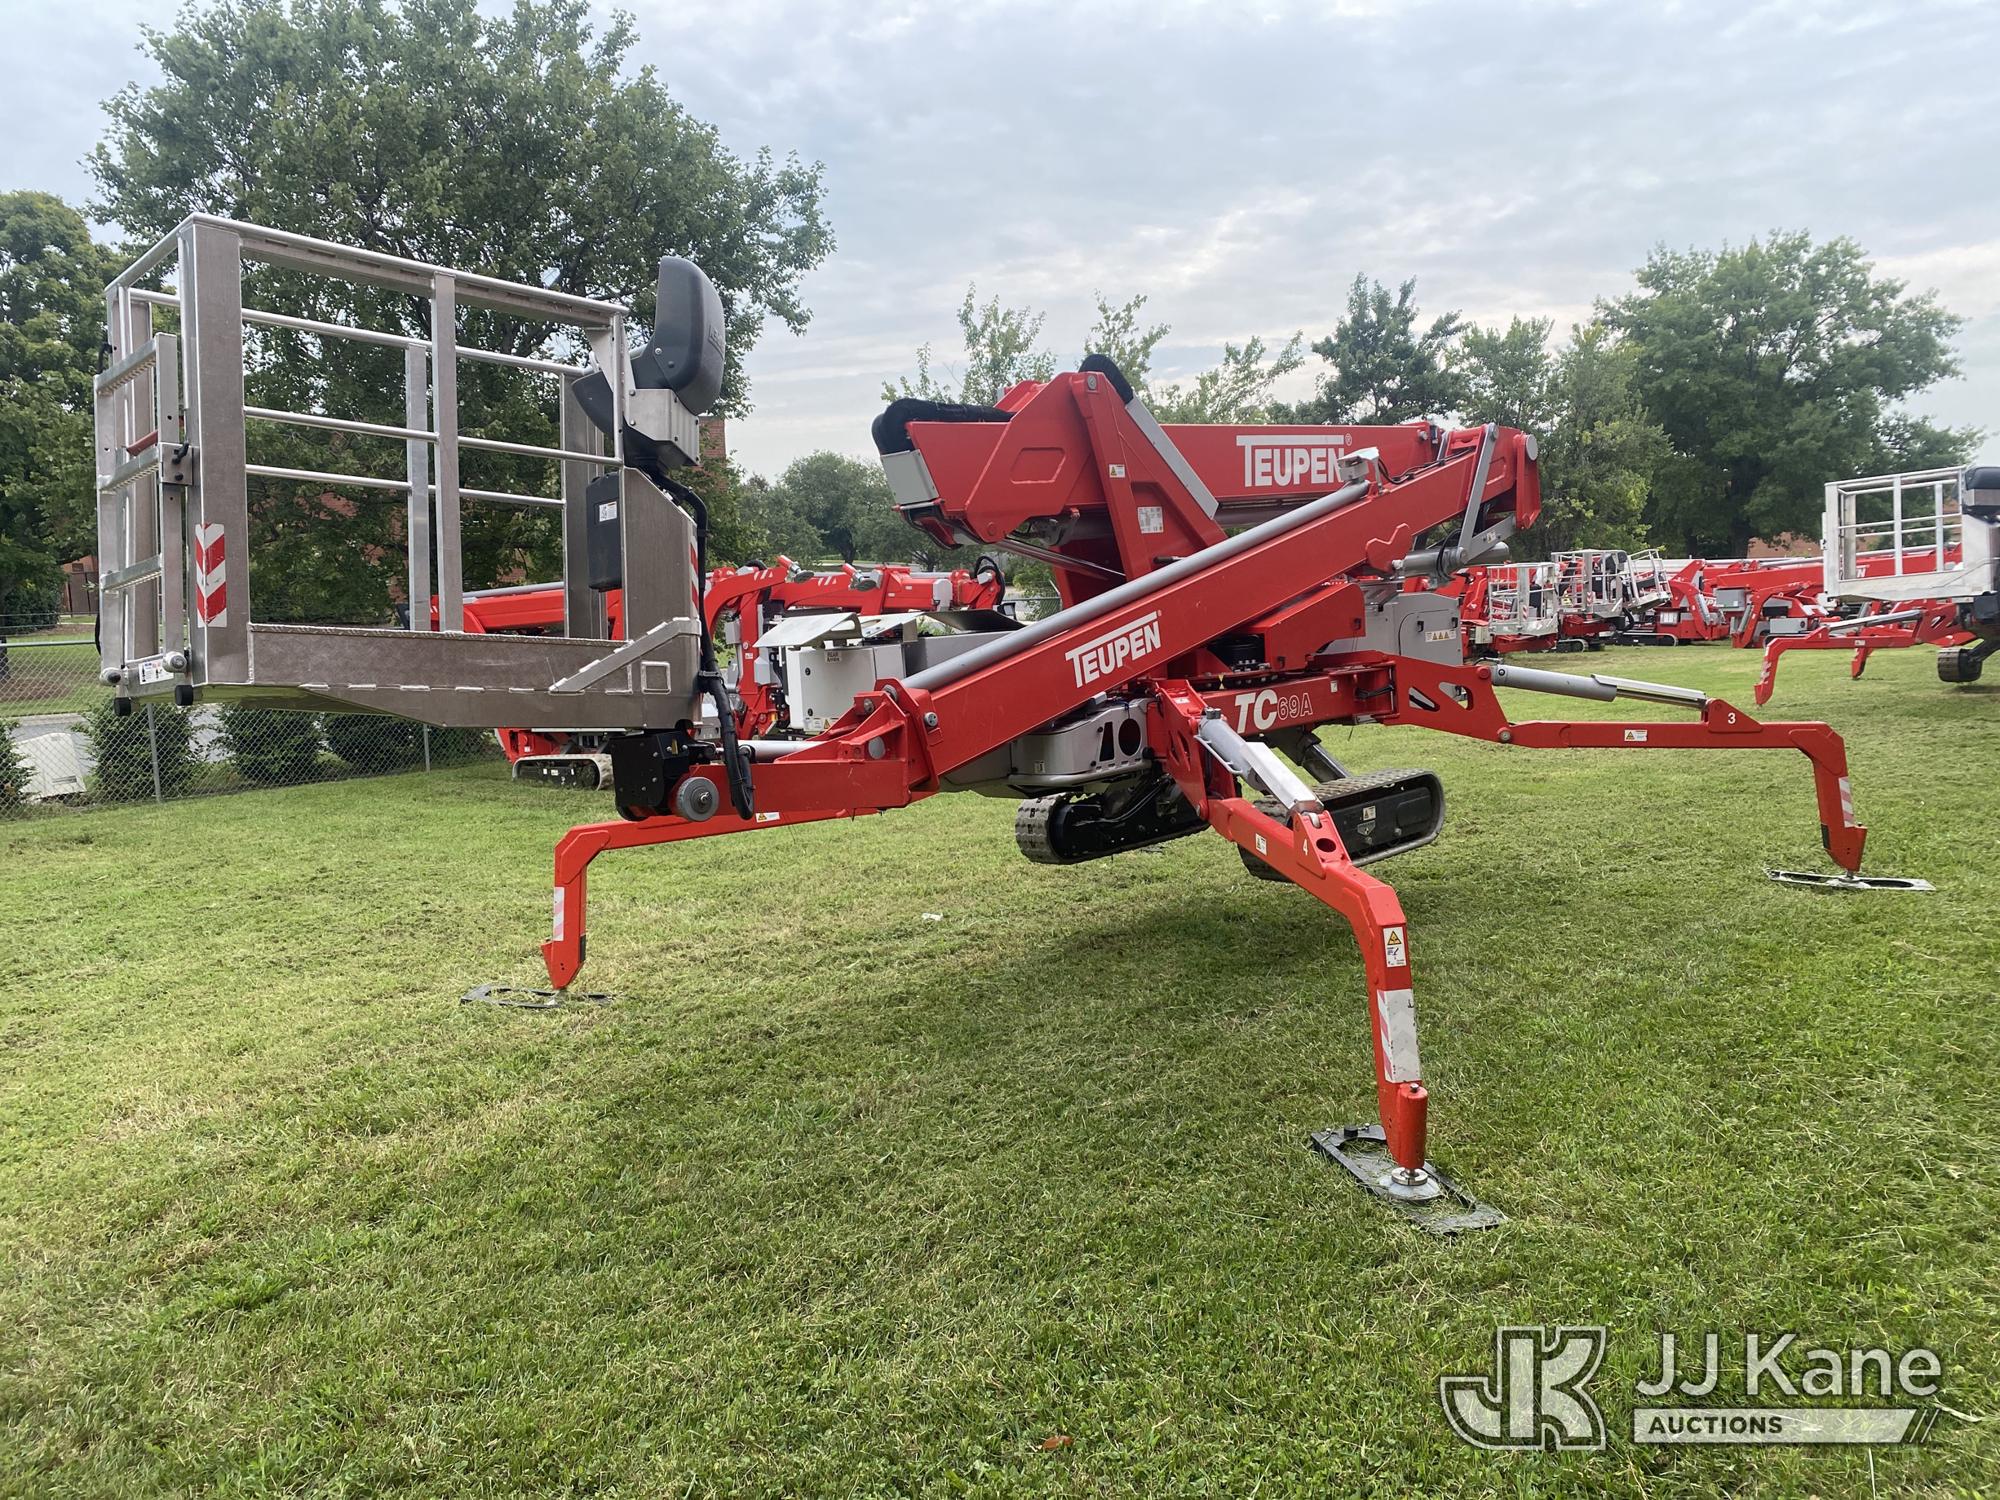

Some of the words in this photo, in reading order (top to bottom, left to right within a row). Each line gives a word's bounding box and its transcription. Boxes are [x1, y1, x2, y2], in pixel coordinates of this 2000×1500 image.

[1236, 434, 1345, 487] TEUPEN
[1065, 610, 1161, 688] TEUPEN
[1235, 689, 1313, 734] TC69A
[1727, 712, 1736, 724] 3
[1303, 838, 1308, 856] 4
